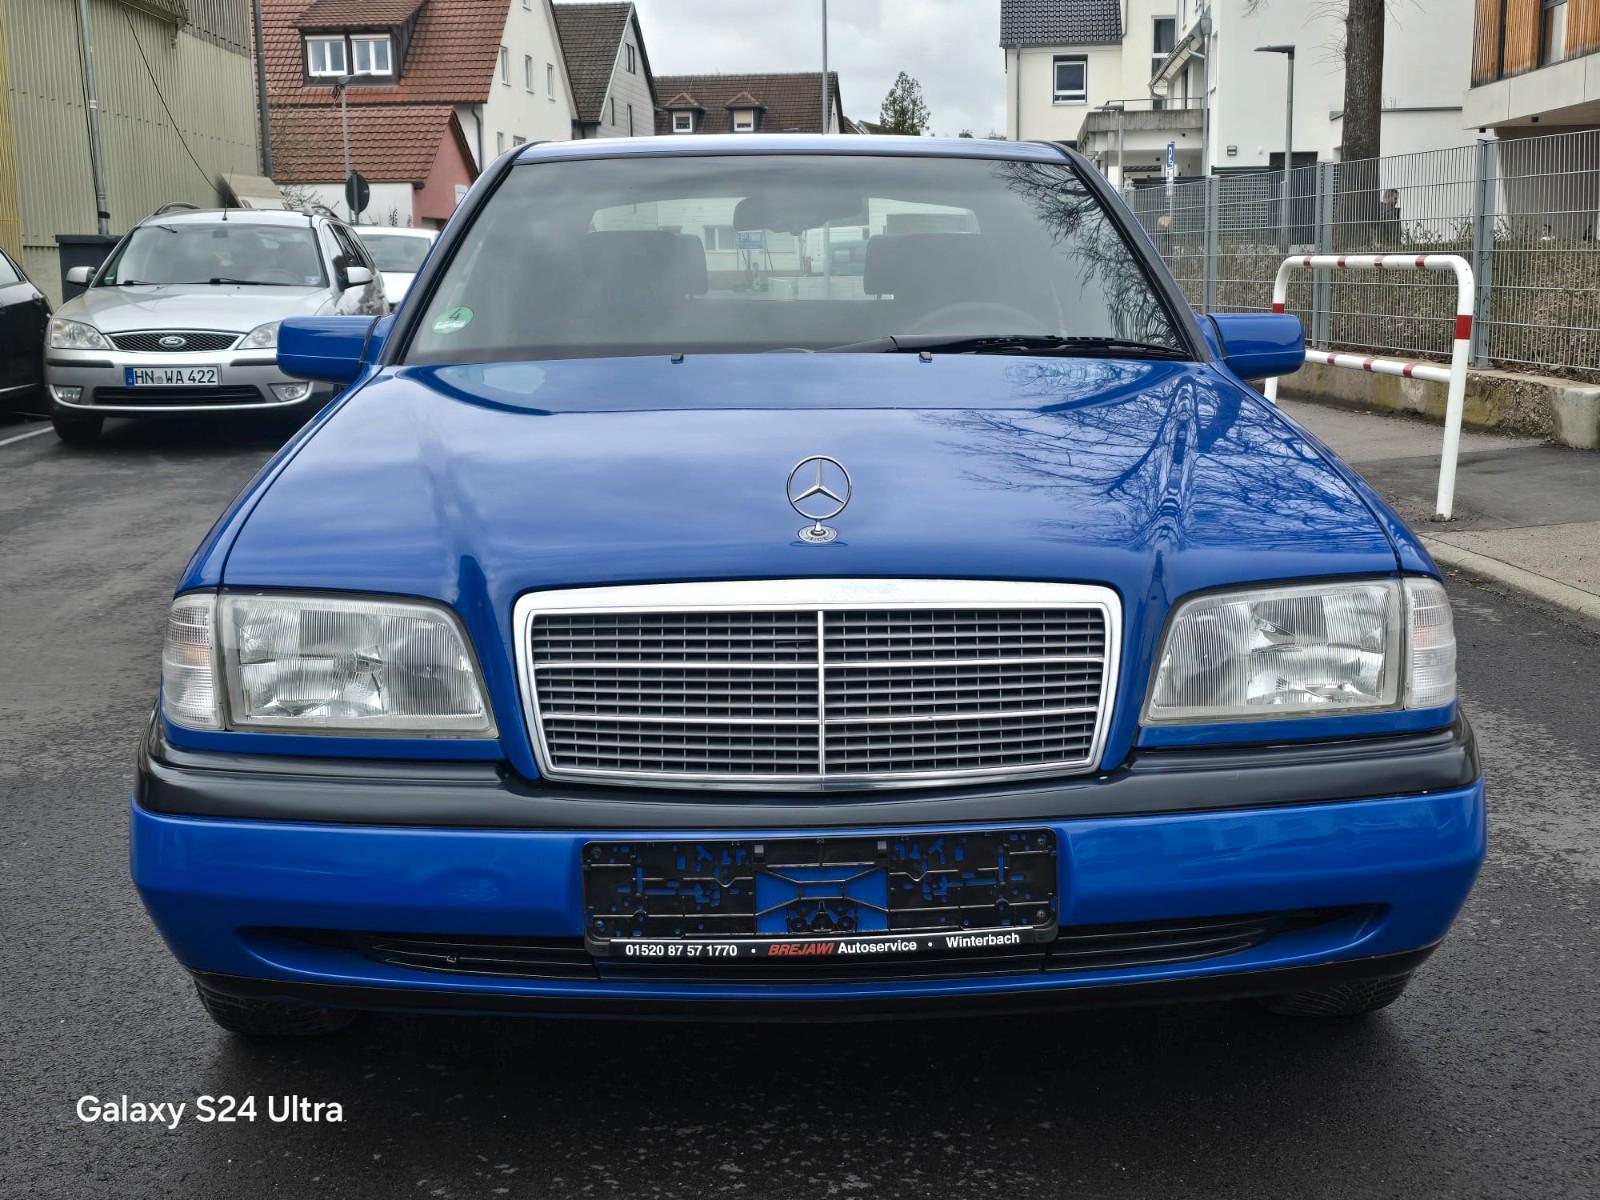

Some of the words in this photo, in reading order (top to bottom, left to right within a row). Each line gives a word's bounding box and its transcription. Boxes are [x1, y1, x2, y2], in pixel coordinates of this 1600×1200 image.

[135, 370, 154, 384] HN
[165, 370, 184, 384] WA
[188, 369, 216, 384] 422
[625, 944, 665, 956] 01520
[667, 944, 683, 956] 87
[686, 944, 703, 957] 57
[706, 944, 738, 957] 1770
[768, 943, 834, 956] BREJAWI
[837, 939, 917, 954] Autoservice
[946, 932, 1020, 949] Winterbach
